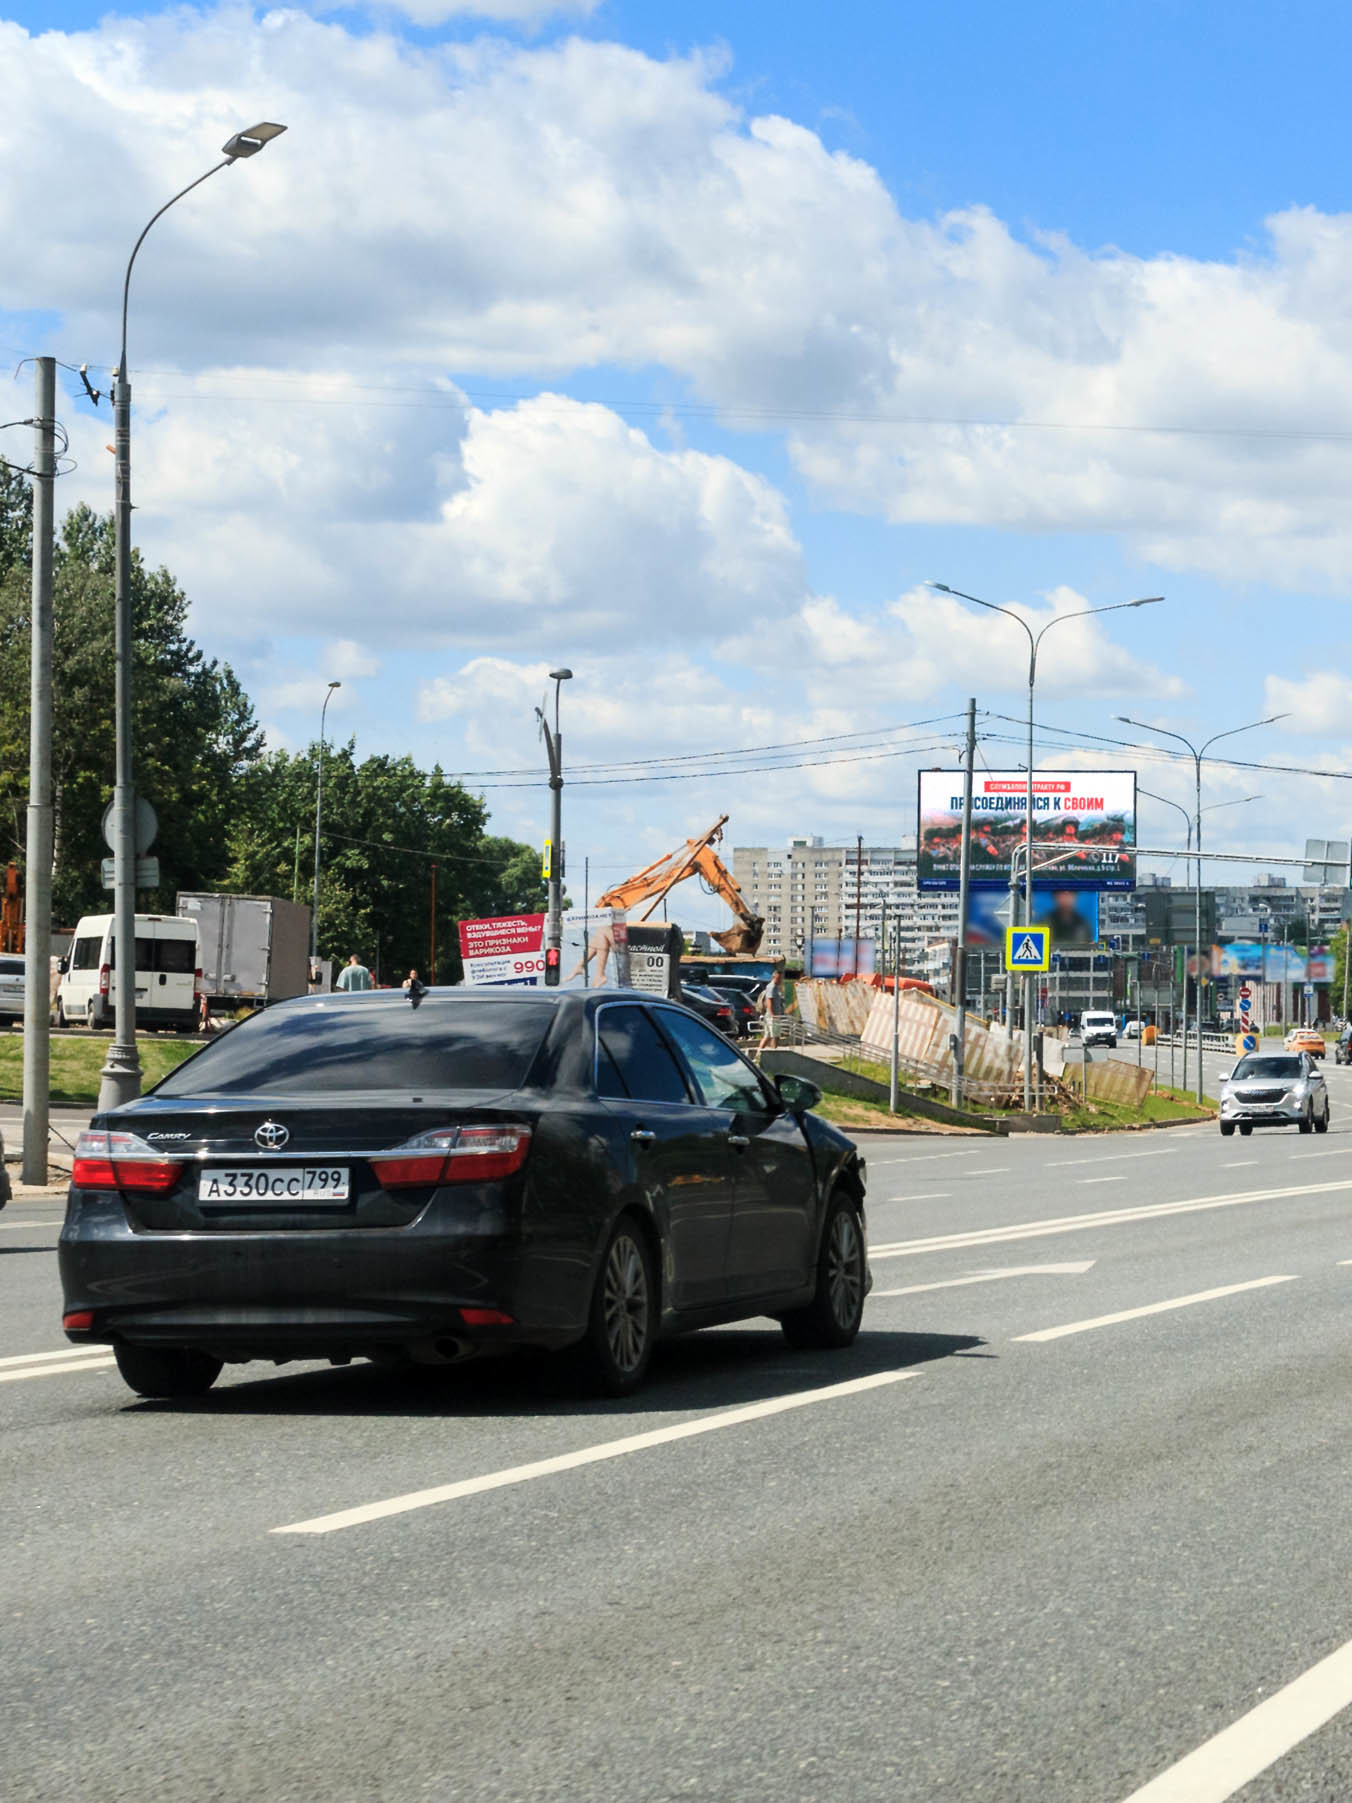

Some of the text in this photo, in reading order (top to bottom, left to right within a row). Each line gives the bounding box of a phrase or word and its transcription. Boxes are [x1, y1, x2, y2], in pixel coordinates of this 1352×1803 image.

[950, 794, 1104, 811] ПРСОЕДИНЯЙСЯ К СВОИМ
[468, 936, 529, 949] ЭТО ПРИЗНАКИ
[469, 945, 512, 956] ВАРИКОЗА
[513, 959, 546, 974] 990
[207, 1170, 343, 1198] А330СС 799
